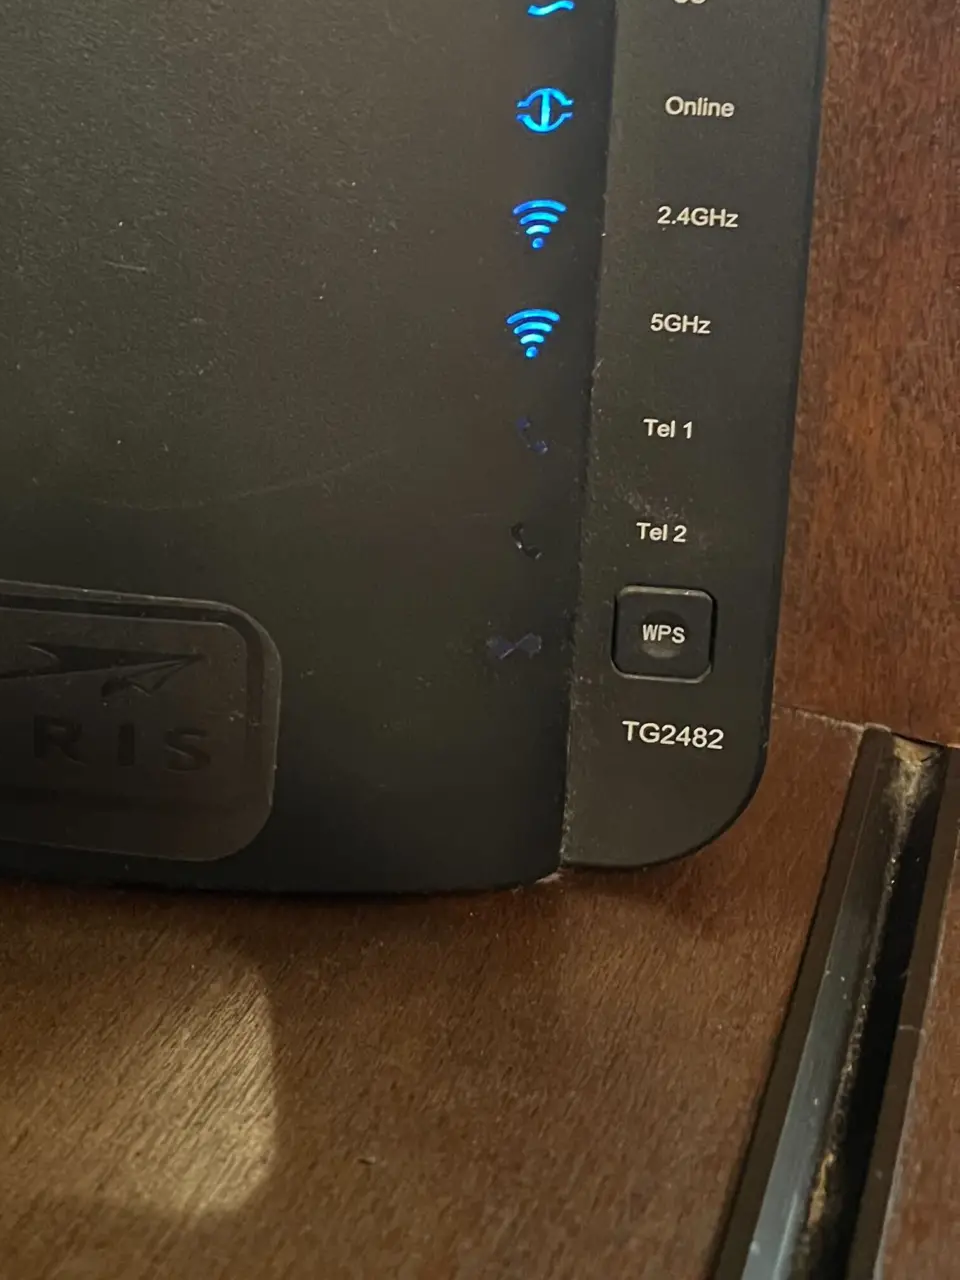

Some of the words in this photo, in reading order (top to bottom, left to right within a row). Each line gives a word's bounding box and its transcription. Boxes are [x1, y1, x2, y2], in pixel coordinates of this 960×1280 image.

[665, 95, 735, 118] Online
[656, 205, 739, 229] 2.4GHz
[649, 313, 711, 335] 5GHz
[643, 418, 677, 439] Tel
[682, 420, 694, 440] 1
[636, 521, 669, 542] Tel
[672, 523, 687, 543] 2
[641, 623, 686, 644] WPS
[621, 719, 725, 750] TG2482
